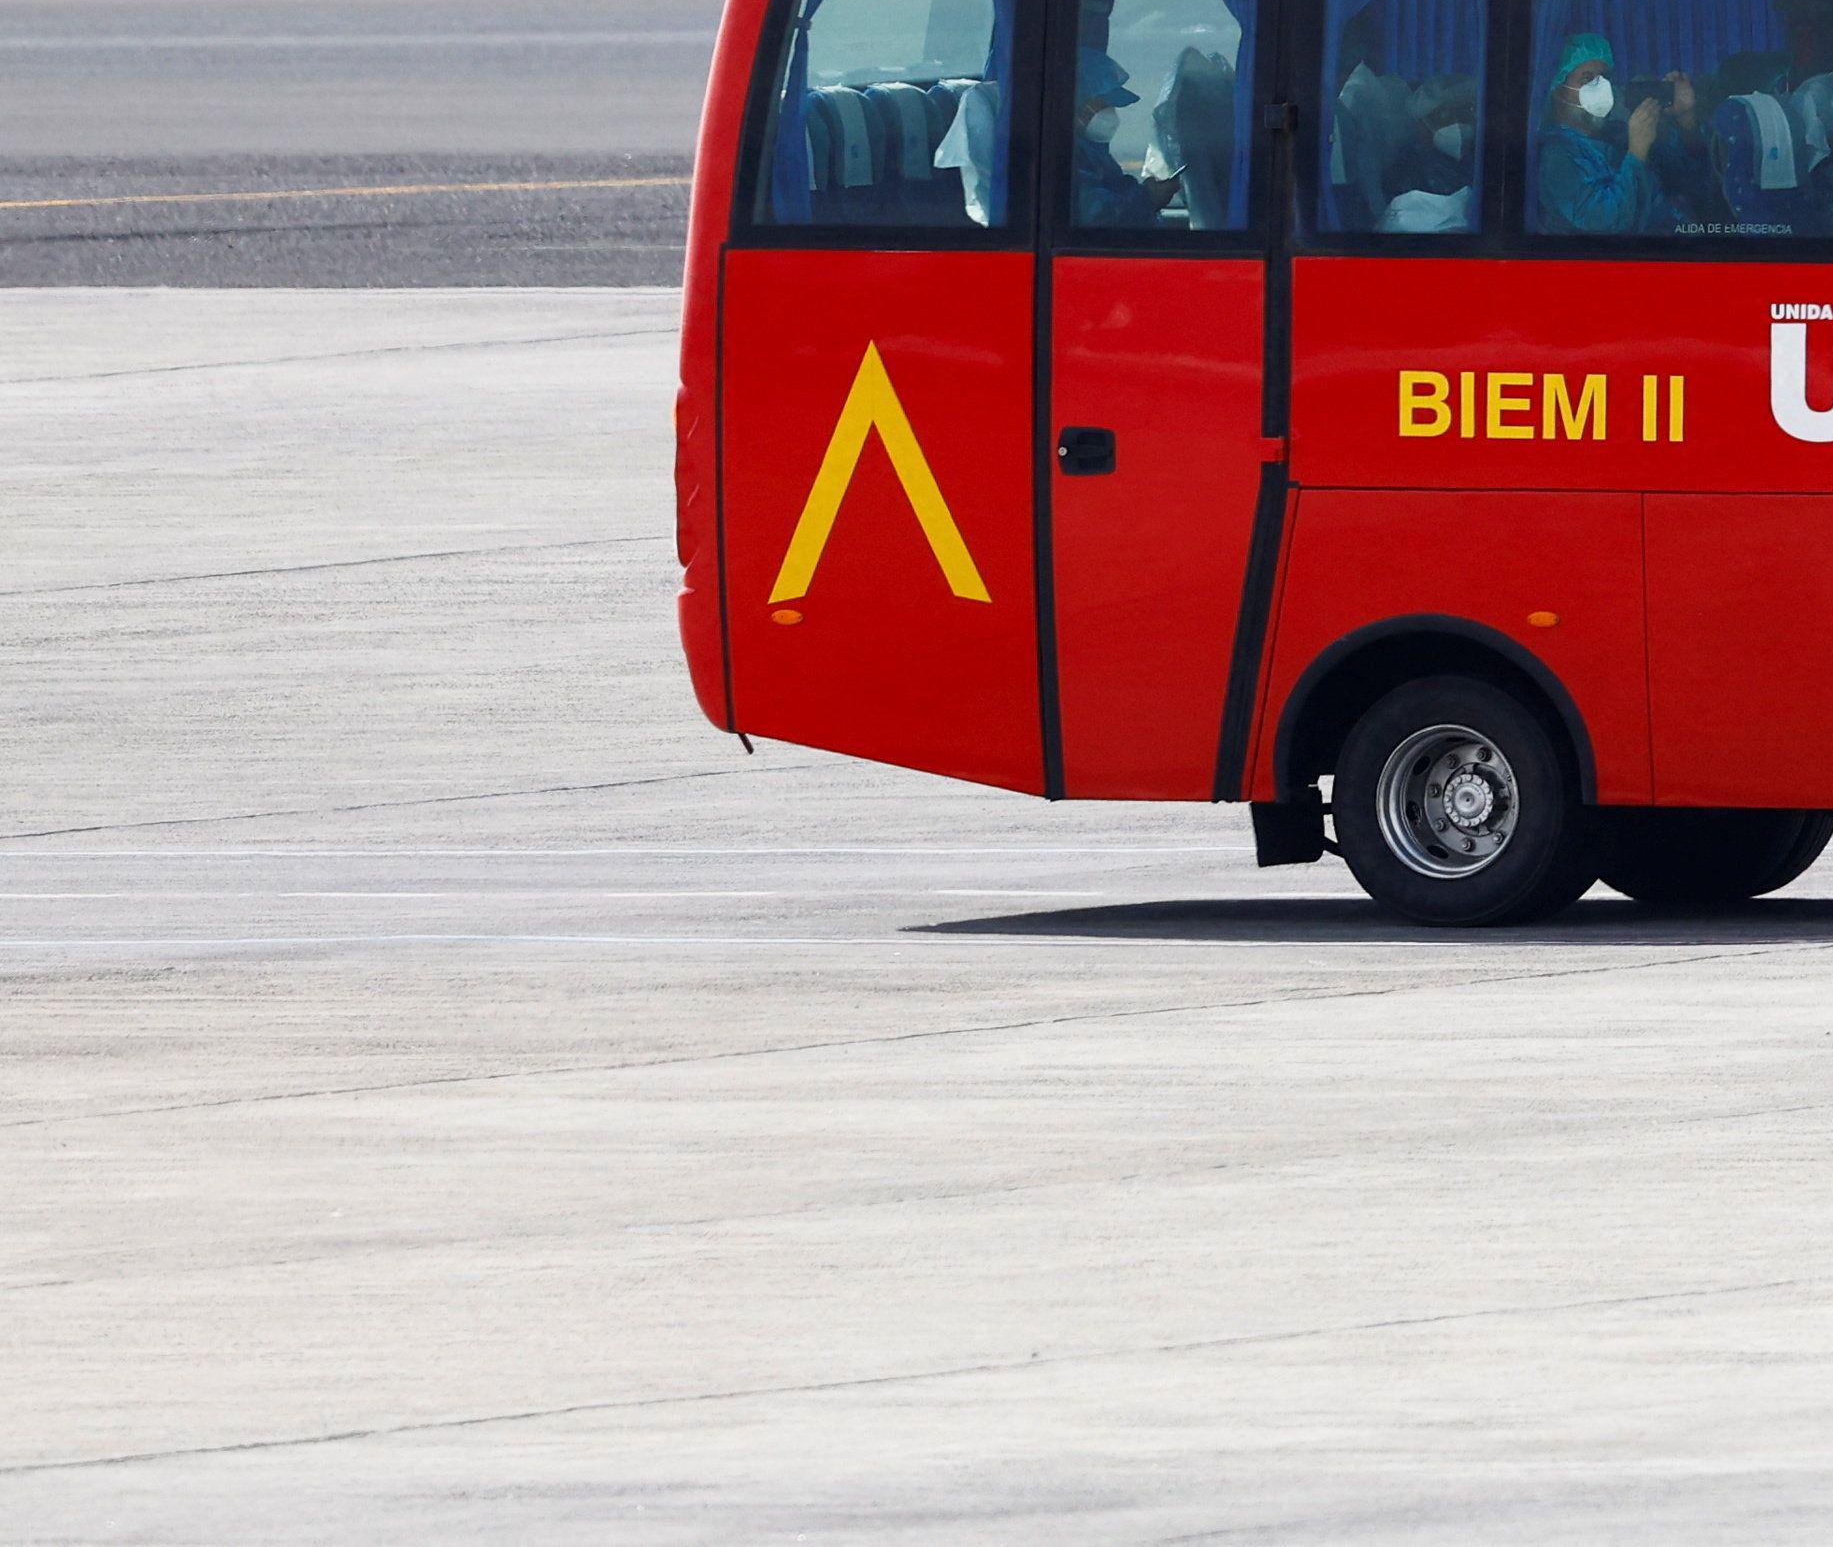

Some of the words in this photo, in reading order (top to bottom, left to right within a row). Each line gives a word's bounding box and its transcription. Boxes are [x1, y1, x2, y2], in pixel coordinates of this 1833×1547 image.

[1707, 223, 1722, 234] DE
[1724, 223, 1793, 234] EMERGENCIA
[1397, 370, 1607, 442] BIEM
[1643, 374, 1685, 443] II
